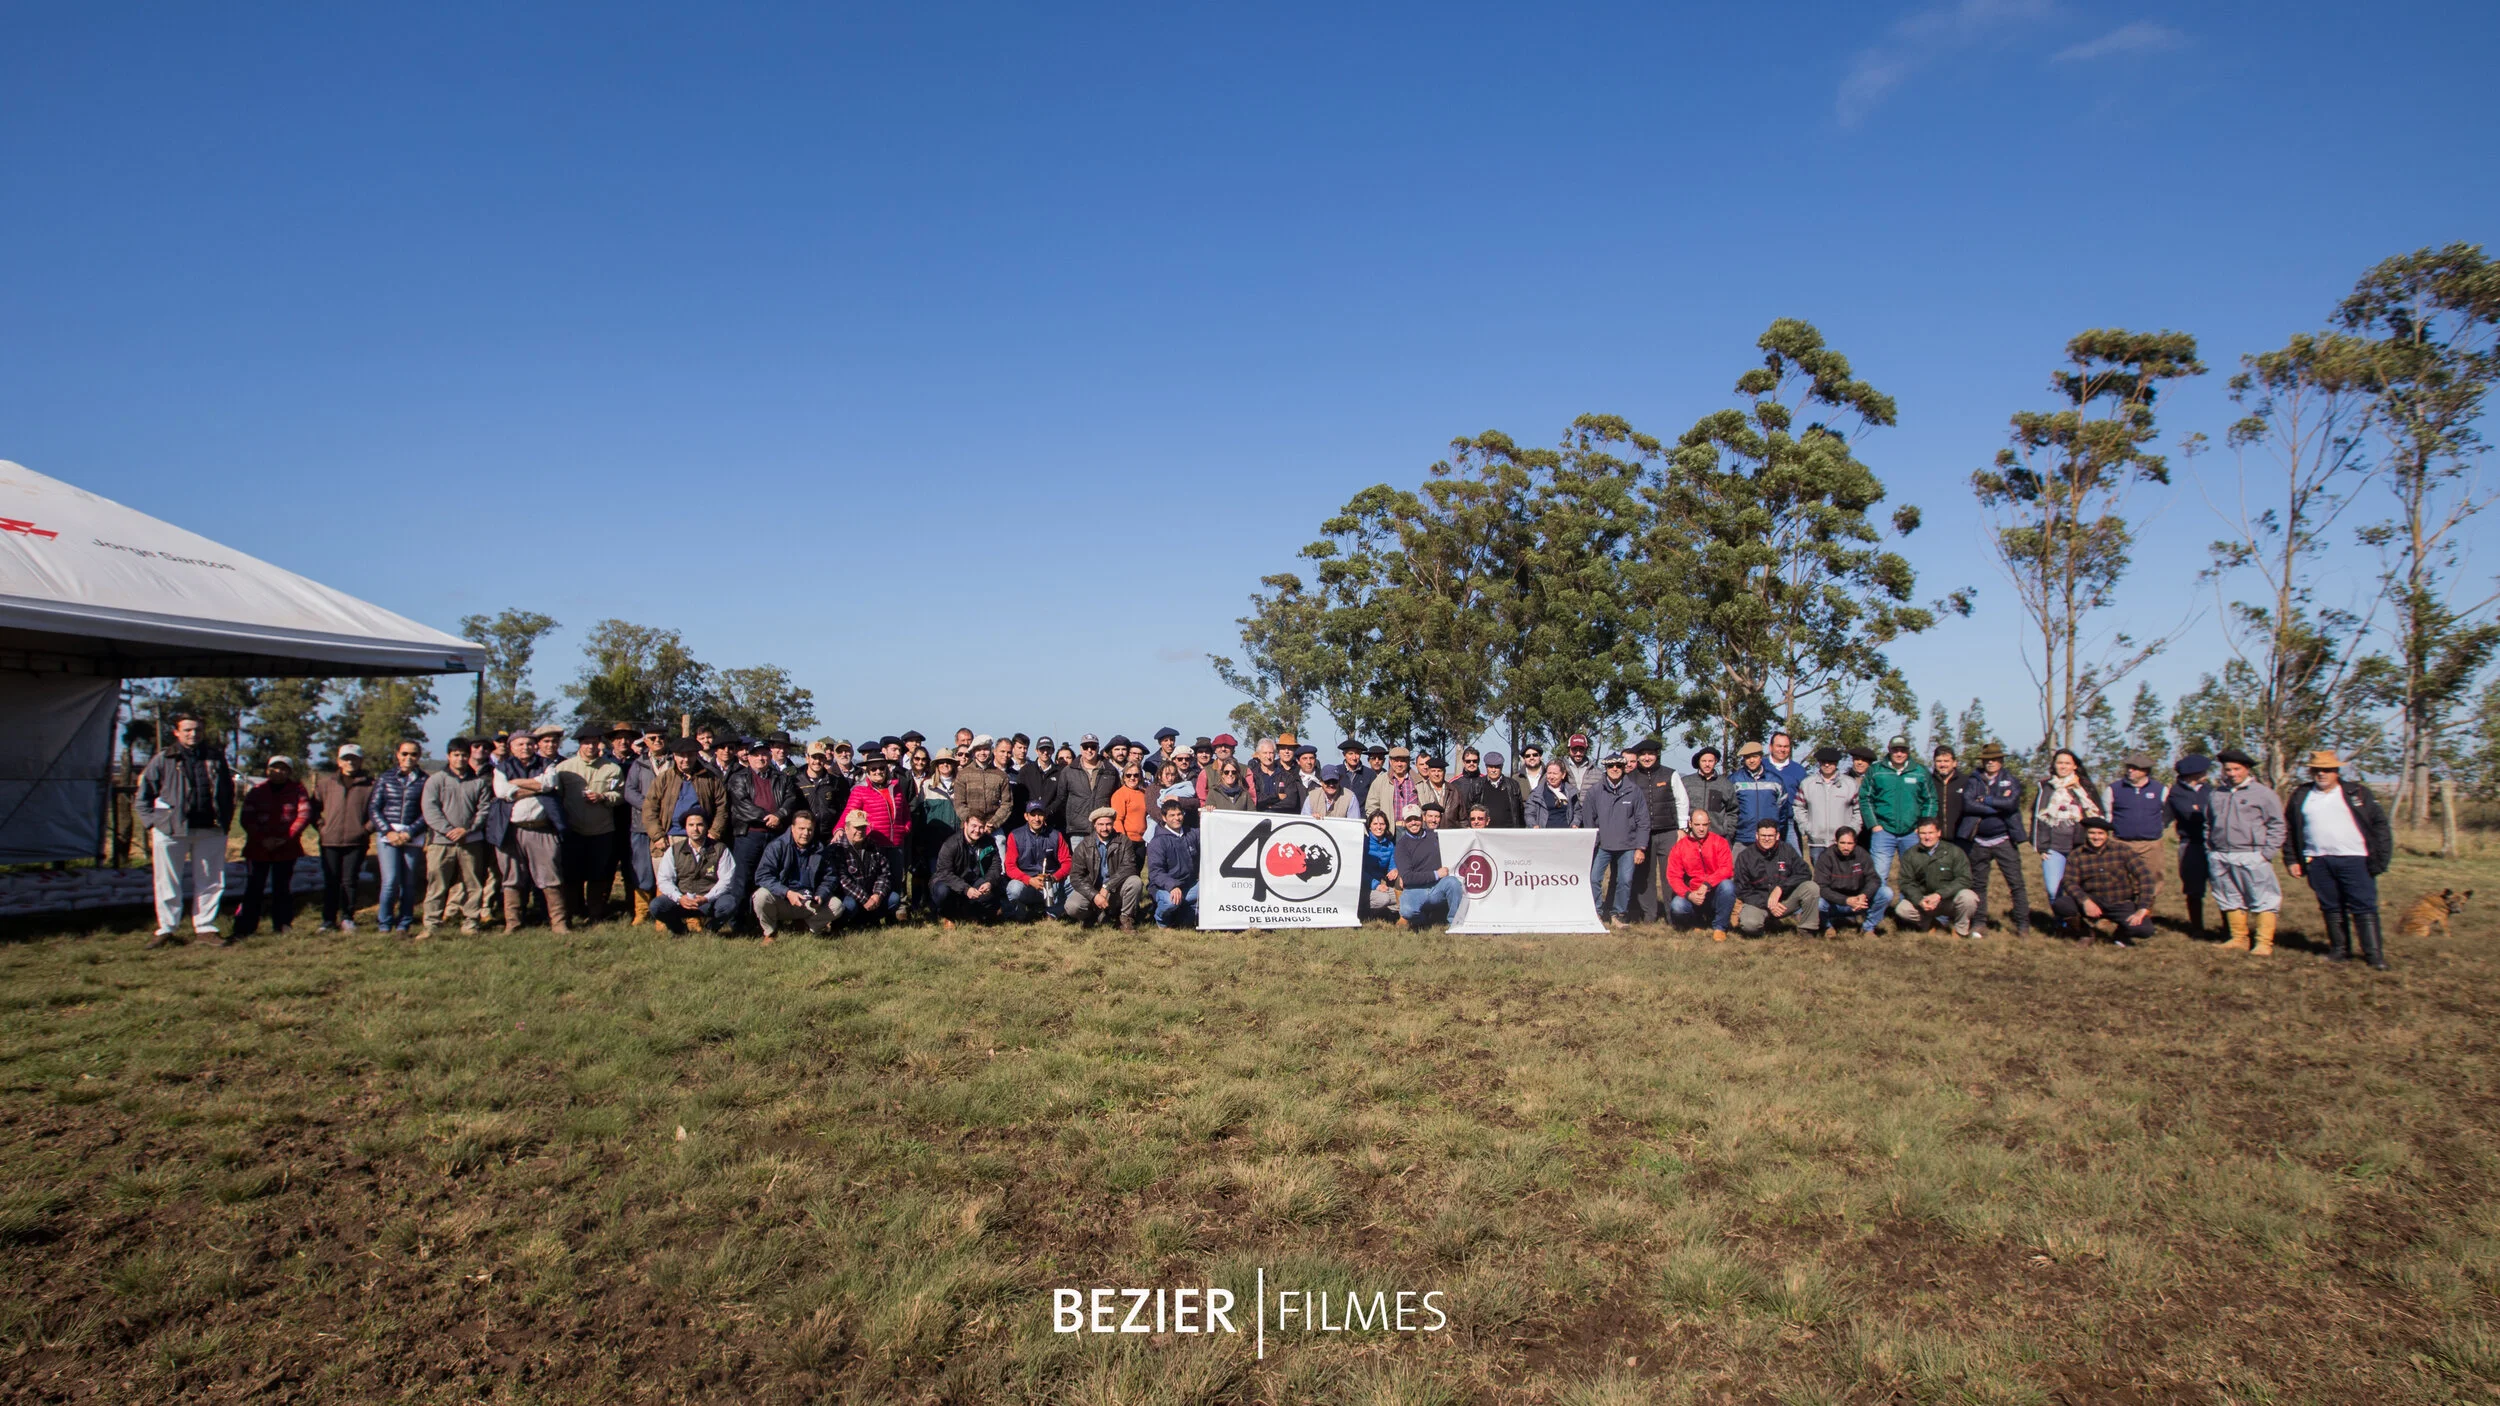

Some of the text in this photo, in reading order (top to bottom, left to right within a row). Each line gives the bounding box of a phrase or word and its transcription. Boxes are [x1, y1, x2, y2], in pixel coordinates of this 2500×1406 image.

[93, 538, 236, 571] Jorge Santos
[1231, 880, 1253, 889] anos
[1503, 871, 1579, 890] Paipasso
[1218, 904, 1339, 914] ASSOCIAÇÃO BRASILEIRA
